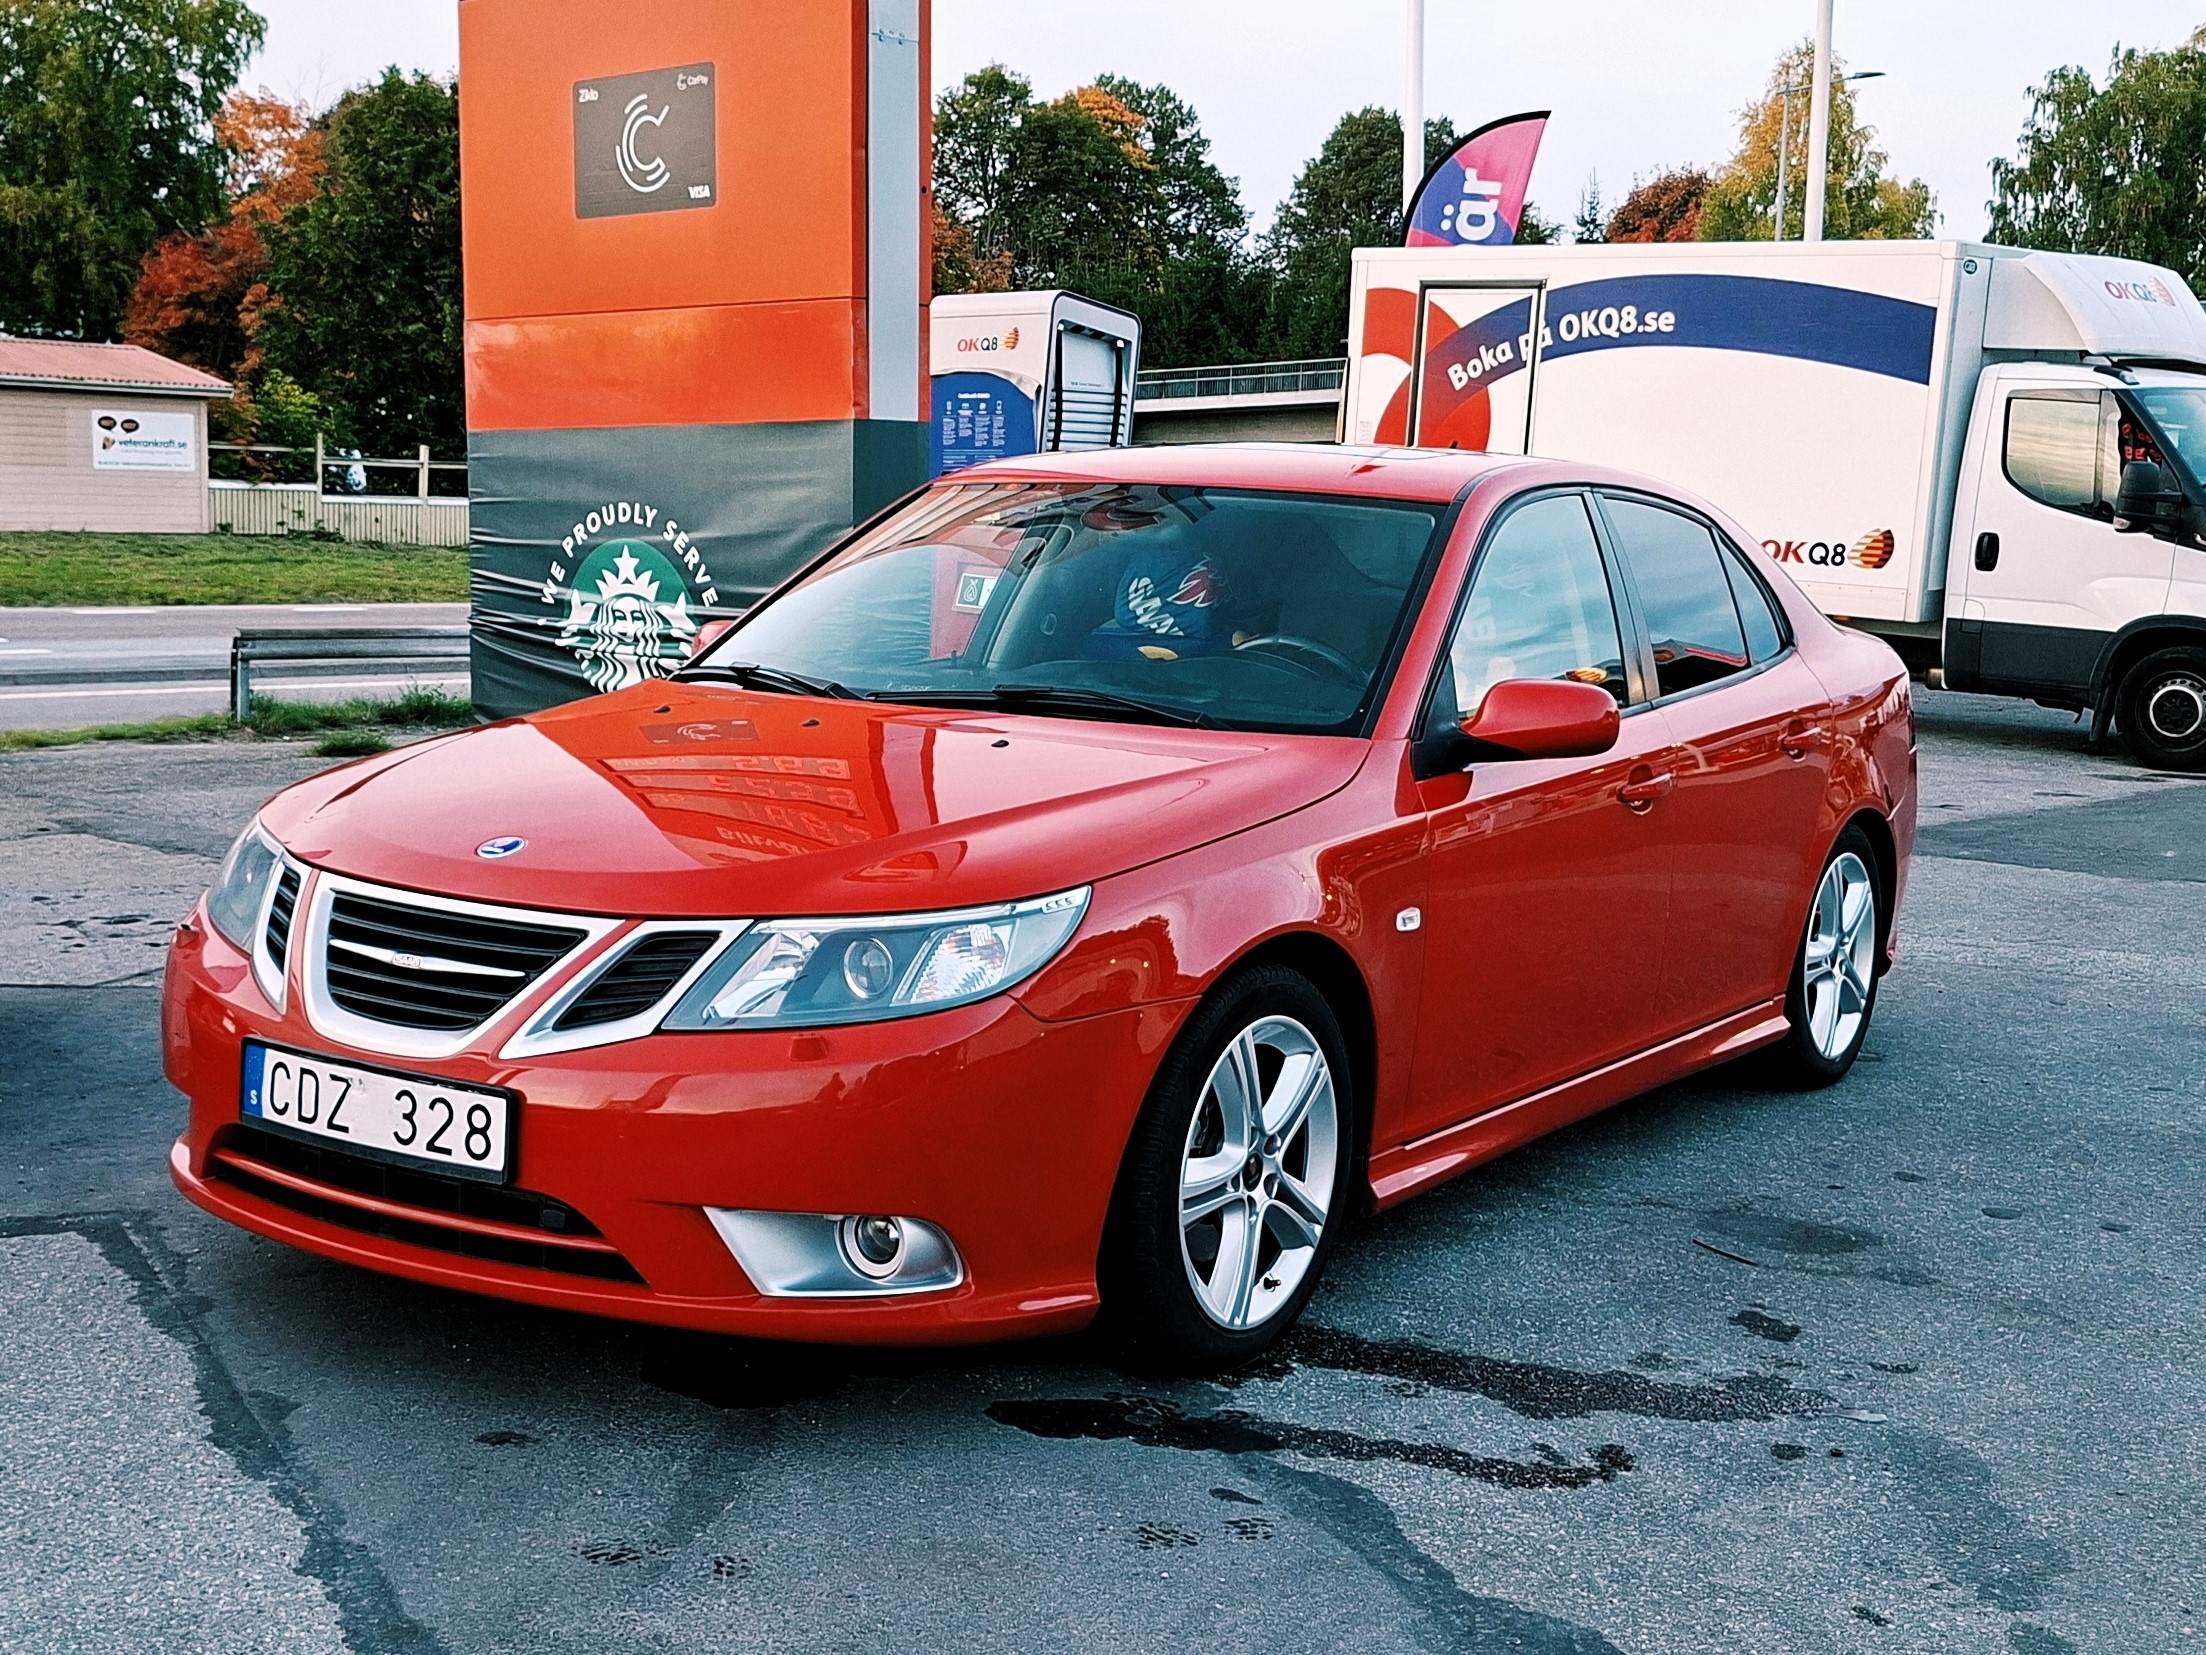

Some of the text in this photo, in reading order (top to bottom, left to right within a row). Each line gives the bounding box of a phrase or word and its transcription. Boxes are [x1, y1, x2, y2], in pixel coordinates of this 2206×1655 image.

[687, 184, 711, 199] VISA
[1440, 166, 1503, 247] är
[1447, 344, 1514, 392] Boka
[1558, 304, 1676, 343] OKQ8.se
[541, 501, 719, 608] WE PROUDLY SERVE
[249, 1089, 258, 1105] S
[269, 1061, 492, 1161] CDZ 328
